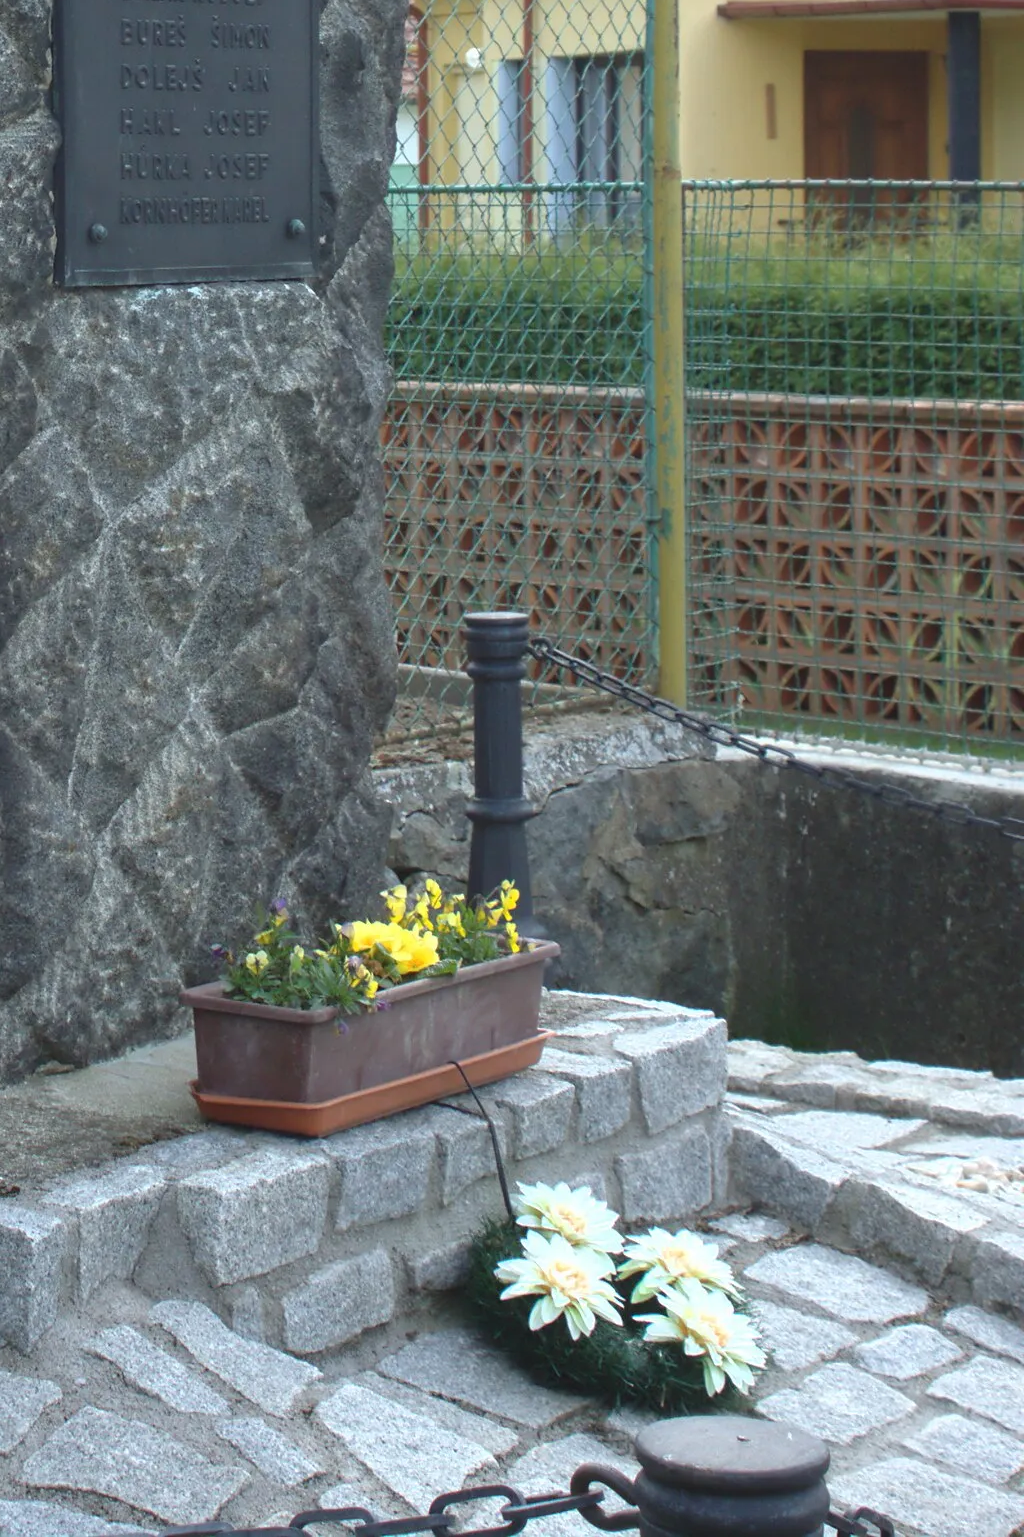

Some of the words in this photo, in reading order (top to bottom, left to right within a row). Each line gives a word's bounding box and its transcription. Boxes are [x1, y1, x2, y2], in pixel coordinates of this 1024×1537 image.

[120, 14, 187, 47] BUREŠ
[210, 14, 271, 50] ŠIMON
[119, 58, 204, 93] DOLEJŠ
[227, 65, 271, 93] JAN
[203, 108, 271, 137] JOSEF
[203, 153, 271, 181] JOSEF
[222, 196, 272, 225] KAREL
